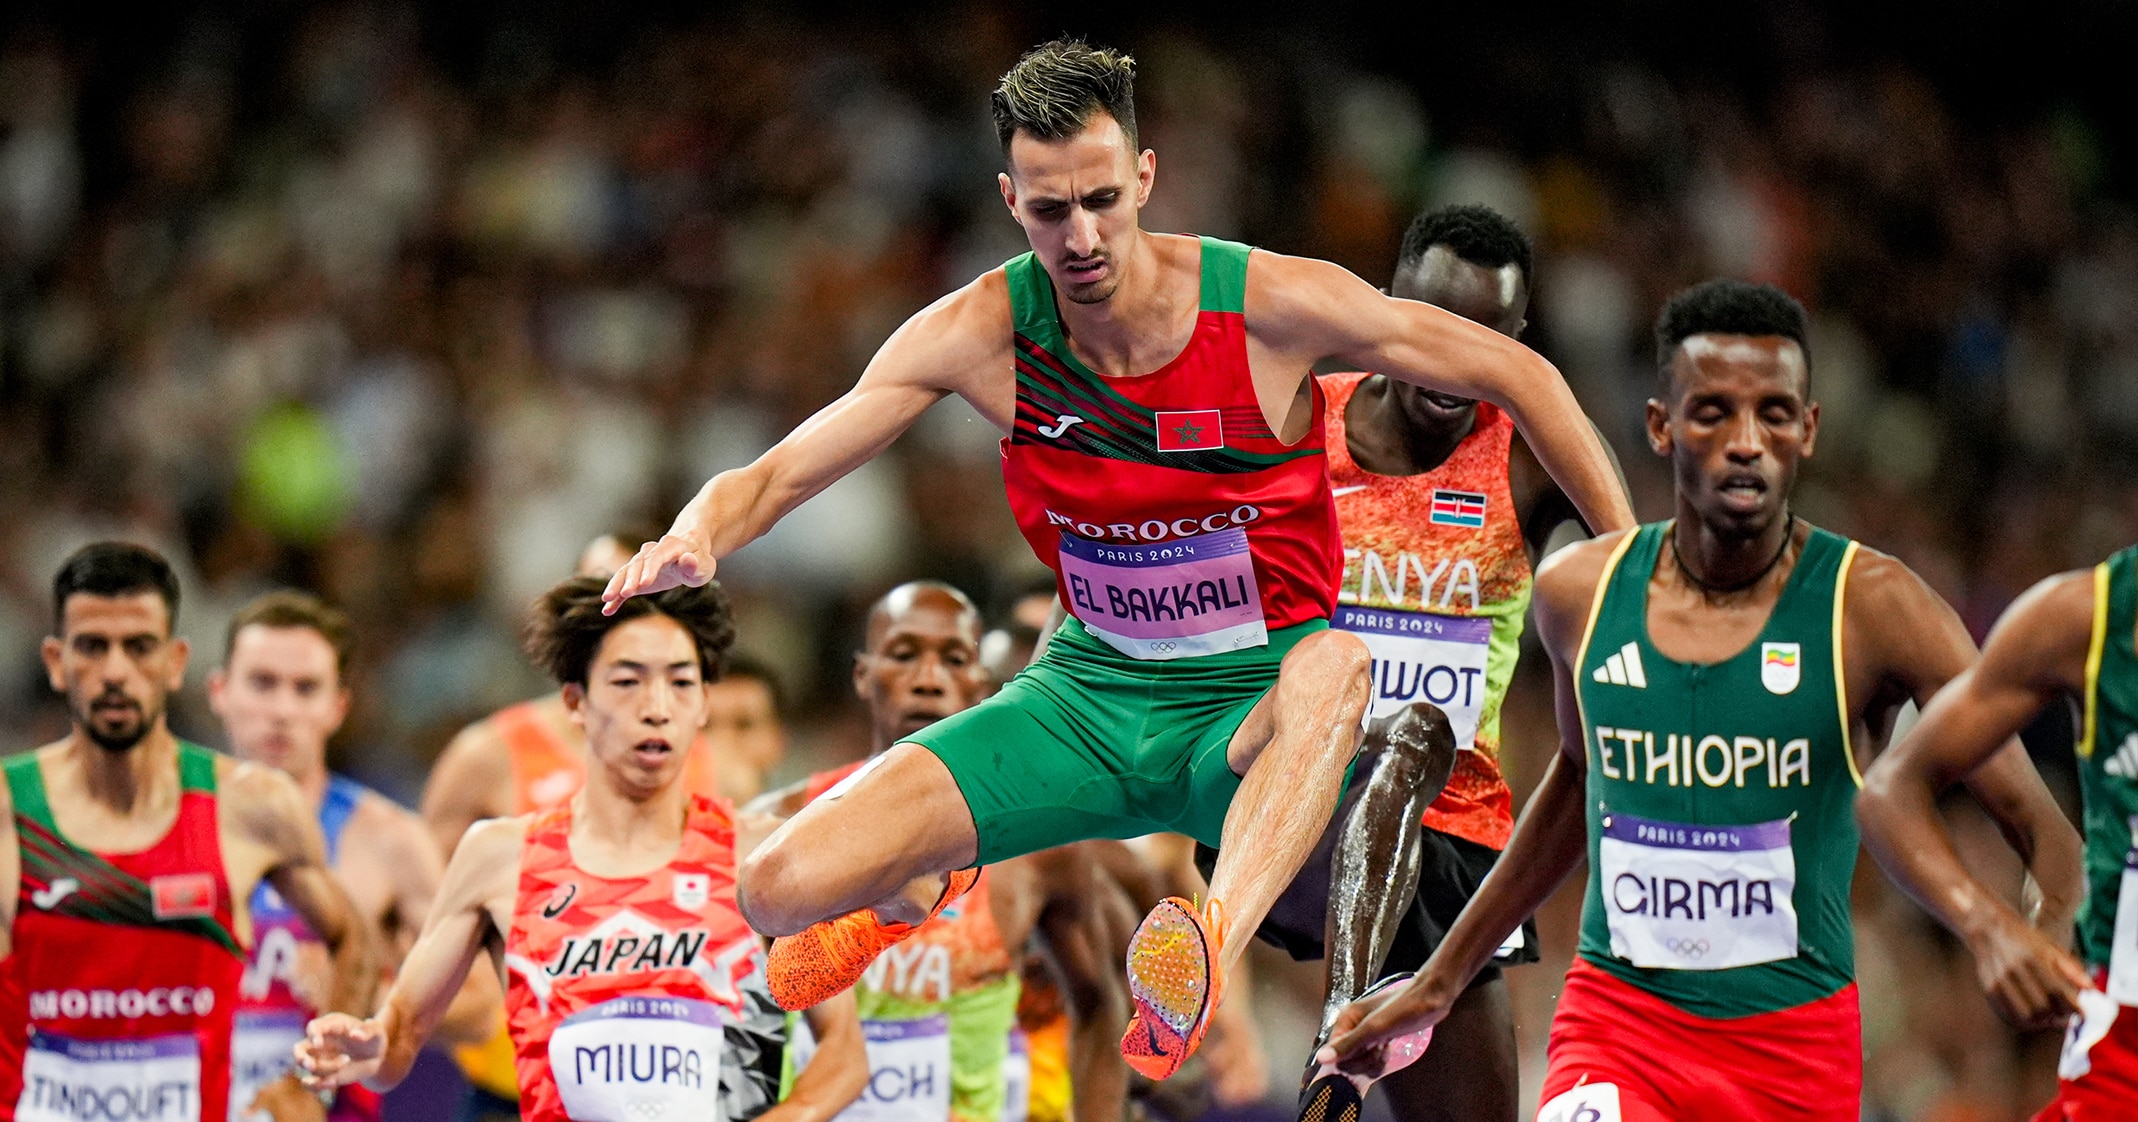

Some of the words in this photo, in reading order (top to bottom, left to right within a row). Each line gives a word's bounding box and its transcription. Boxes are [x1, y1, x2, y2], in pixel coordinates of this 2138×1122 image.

[1045, 504, 1260, 542] MOROCCO
[1097, 549, 1144, 562] PARIS
[1149, 546, 1195, 561] 2024
[1069, 573, 1105, 614] EL
[1105, 575, 1249, 623] BAKKALI
[1345, 613, 1394, 630] PARIS
[1399, 618, 1443, 634] 2024
[1595, 726, 1810, 788] ETHIOPIA
[1637, 824, 1687, 846] PARIS
[1691, 831, 1741, 848] 2024
[1613, 872, 1774, 921] GIRMA
[545, 932, 706, 977] JAPAN
[29, 986, 215, 1020] MOROCCO
[575, 1043, 703, 1090] MIURA
[33, 1075, 191, 1122] TINDOUFT
